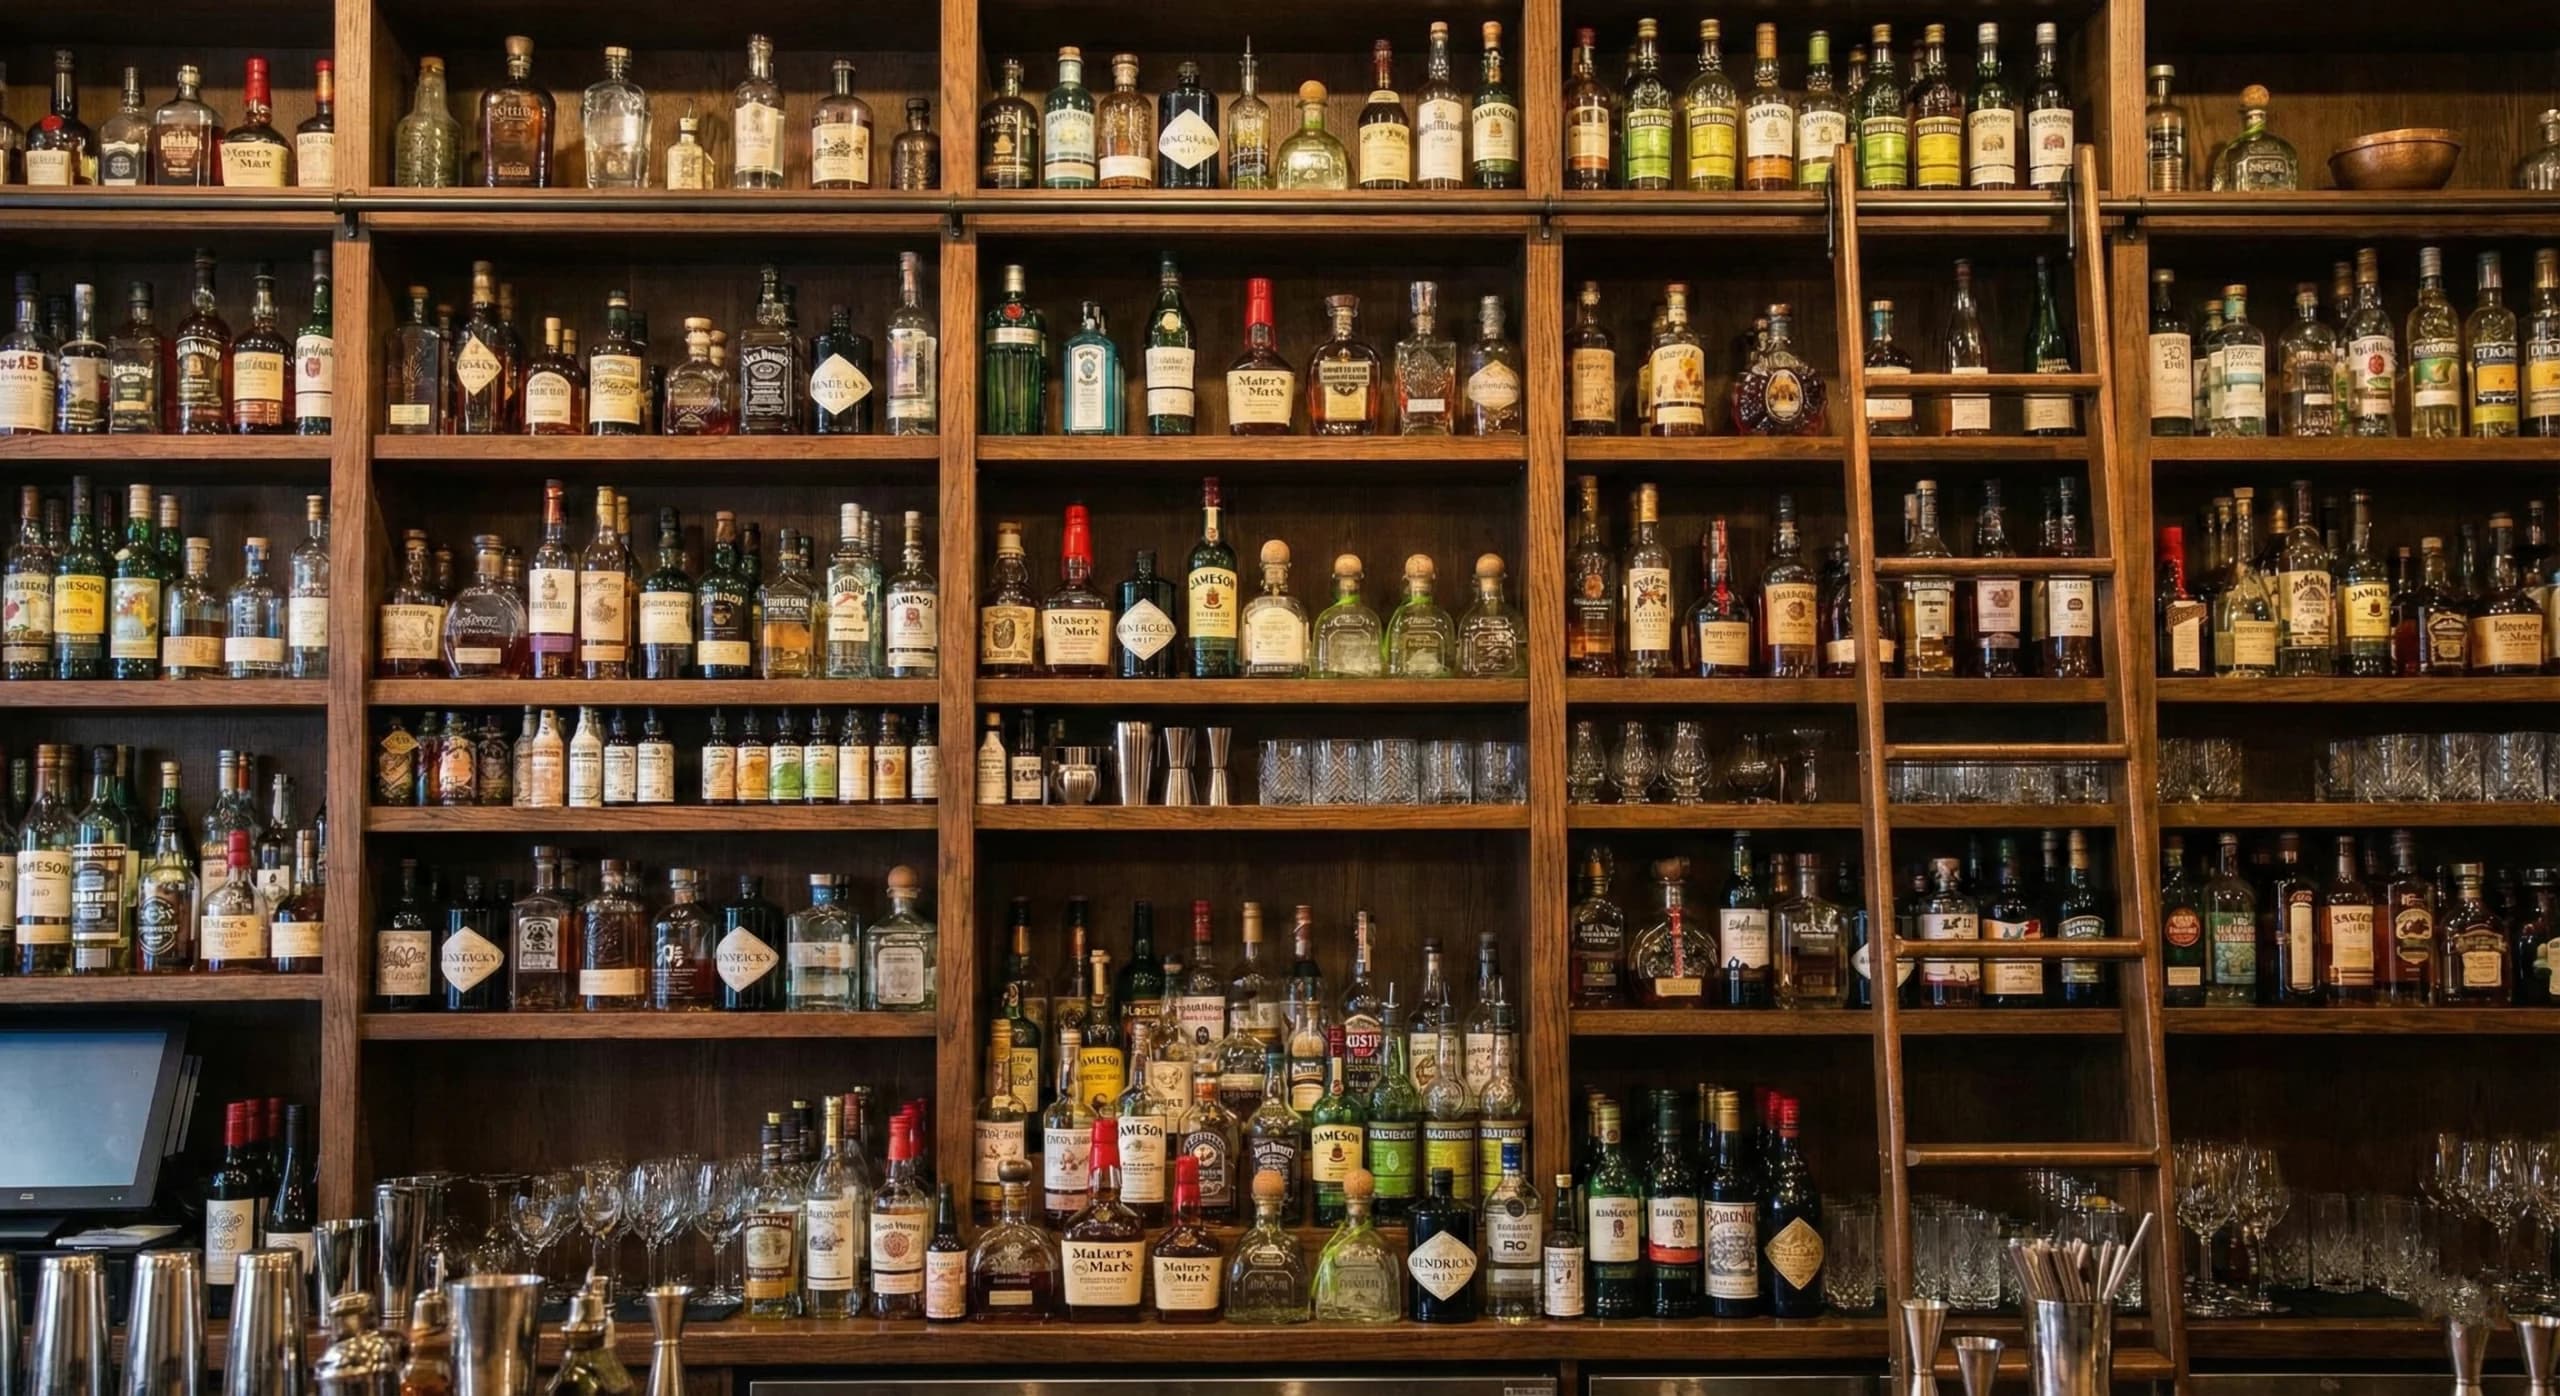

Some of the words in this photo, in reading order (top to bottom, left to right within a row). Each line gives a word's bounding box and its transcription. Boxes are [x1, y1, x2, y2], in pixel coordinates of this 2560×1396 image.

[1189, 573, 1235, 590] JAMESON
[1314, 1130, 1360, 1145] JAMESON
[1503, 1240, 1528, 1252] RO
[1089, 1261, 1134, 1273] Mark
